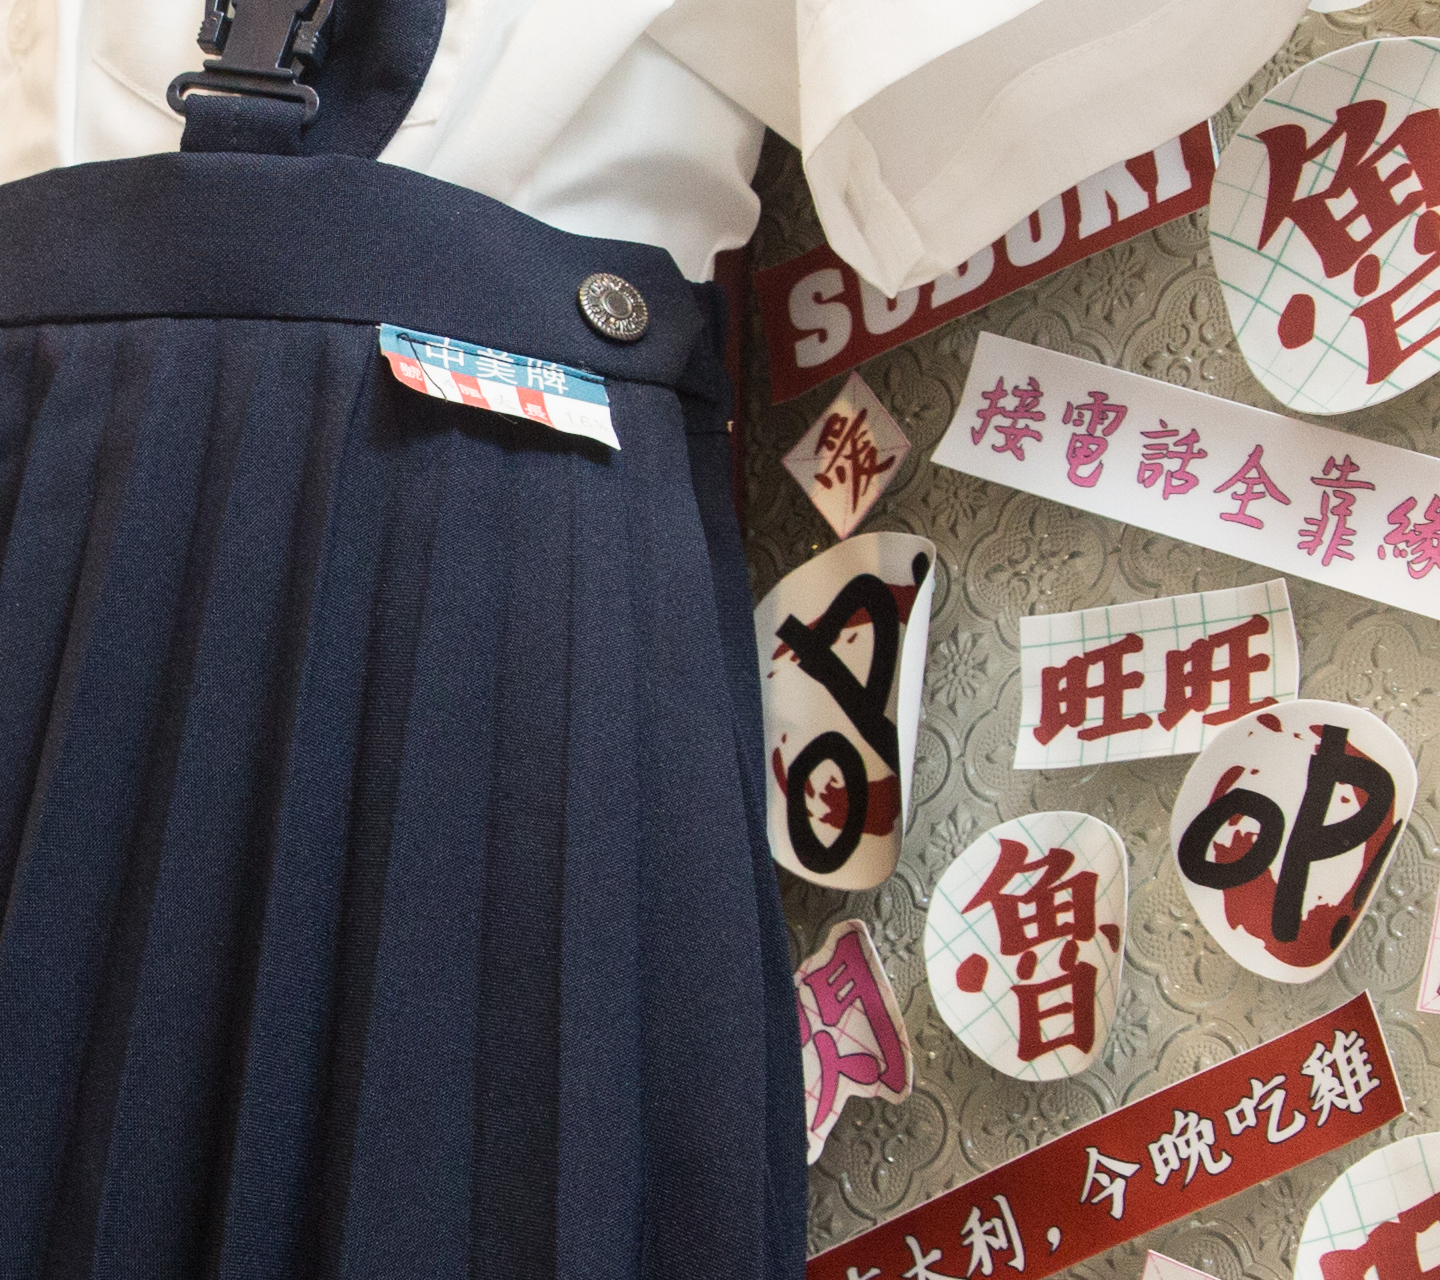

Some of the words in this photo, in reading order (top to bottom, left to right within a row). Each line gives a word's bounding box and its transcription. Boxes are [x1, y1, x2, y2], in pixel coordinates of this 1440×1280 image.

[424, 337, 569, 394] 中美牌
[524, 402, 548, 420] 長
[815, 407, 895, 513] 愛
[1031, 614, 1279, 747] 旺旺
[956, 837, 1120, 1062] 魯
